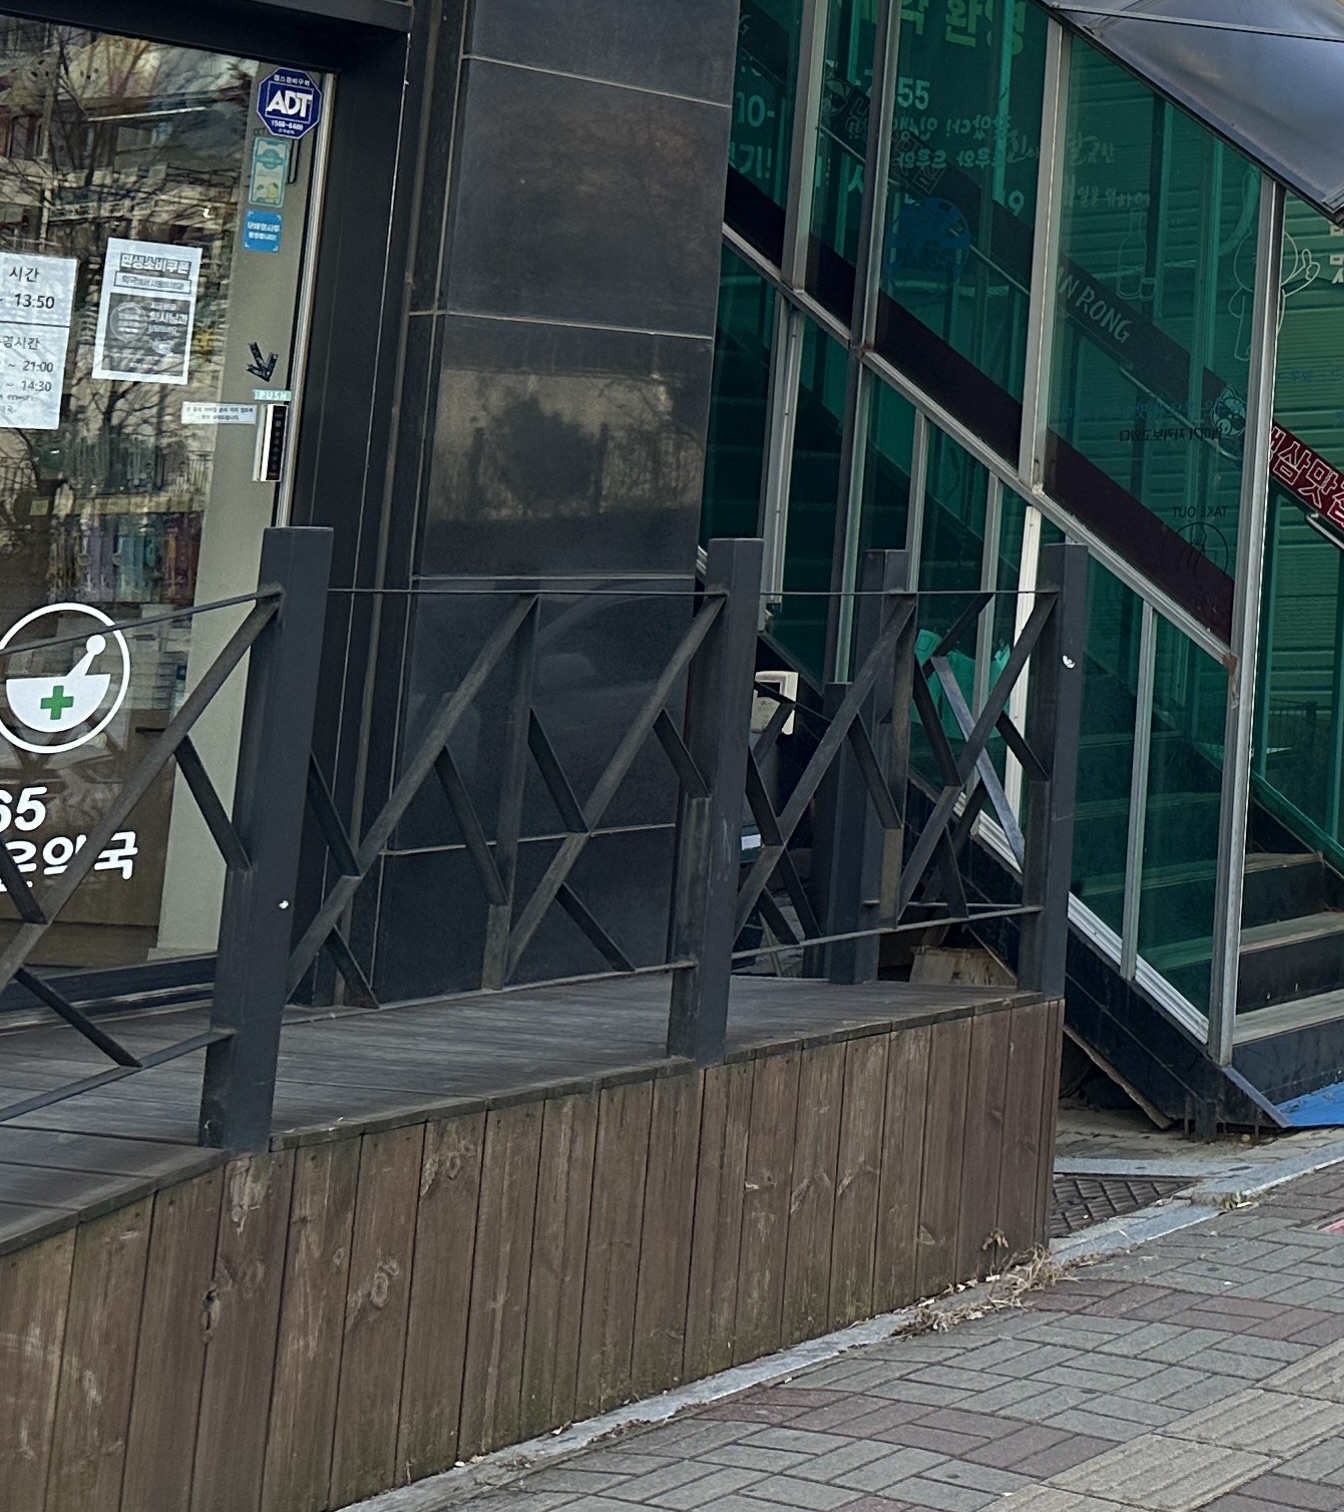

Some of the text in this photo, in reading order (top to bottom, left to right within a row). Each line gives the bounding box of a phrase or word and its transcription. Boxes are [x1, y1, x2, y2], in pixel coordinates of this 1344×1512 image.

[266, 90, 313, 118] ADT
[15, 293, 56, 310] 13:50
[260, 390, 287, 399] PUSH
